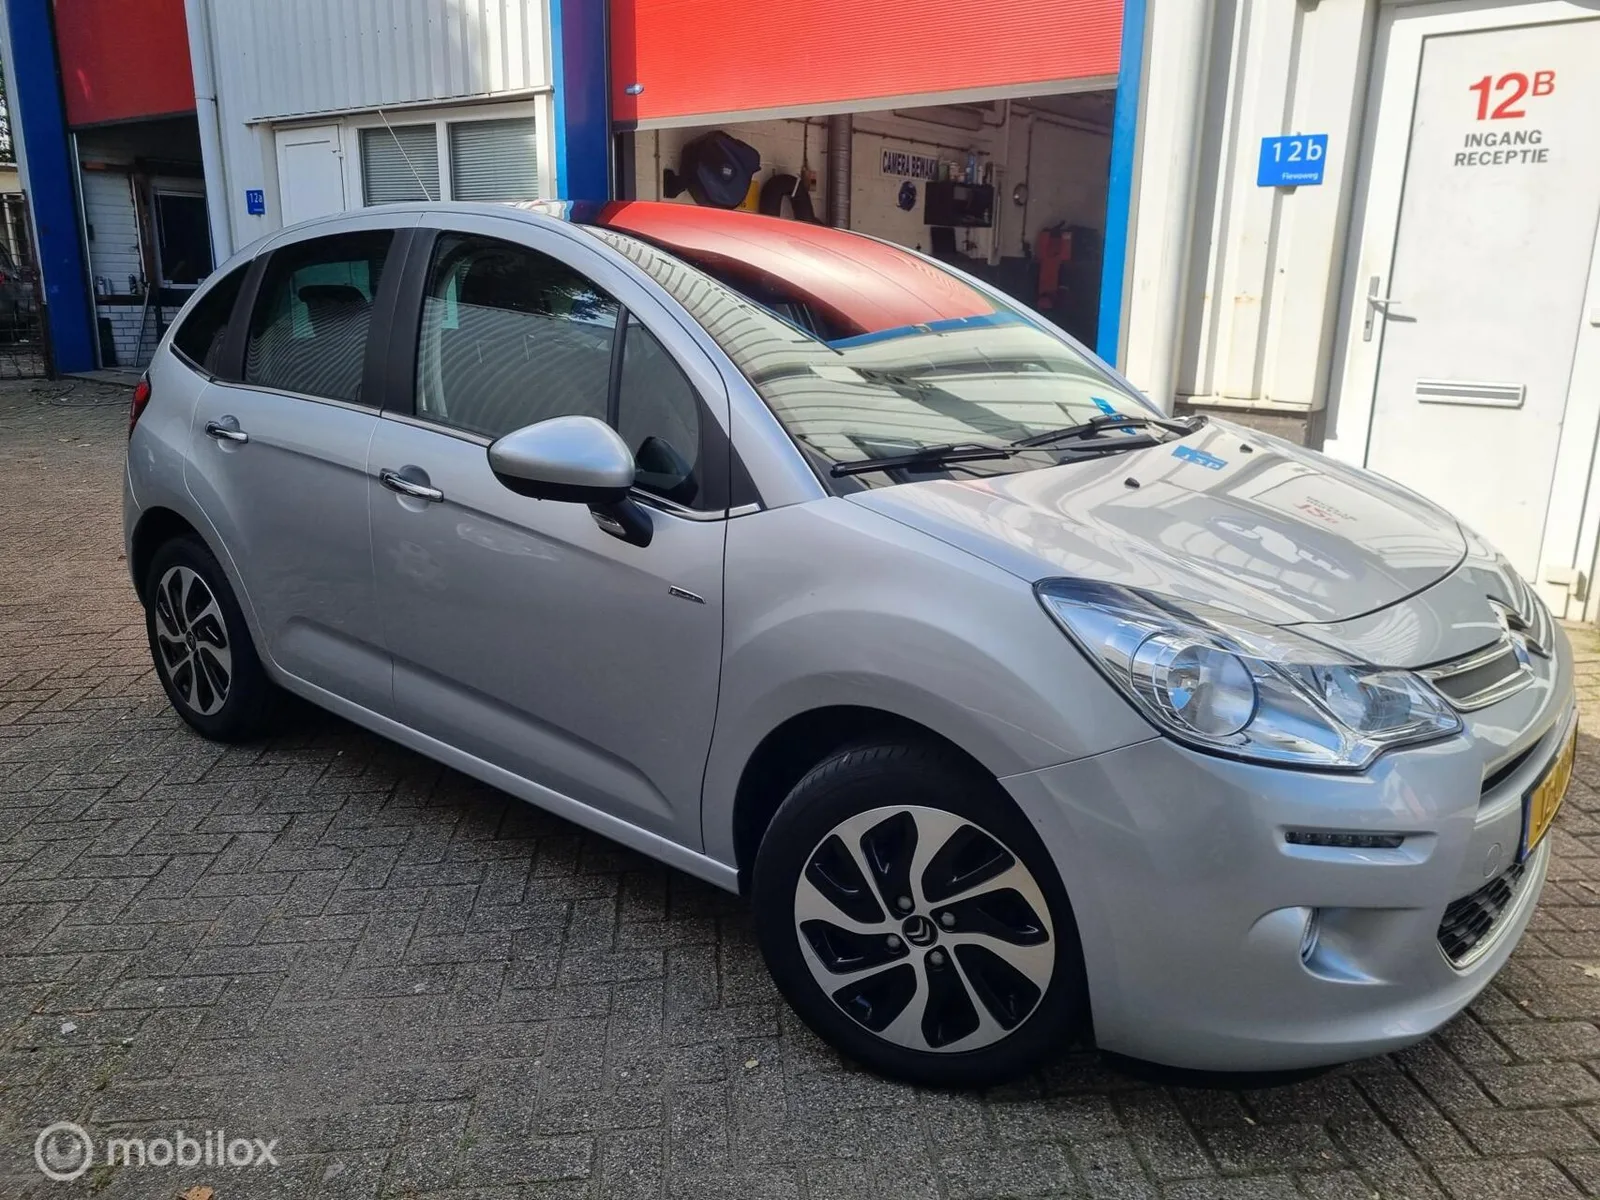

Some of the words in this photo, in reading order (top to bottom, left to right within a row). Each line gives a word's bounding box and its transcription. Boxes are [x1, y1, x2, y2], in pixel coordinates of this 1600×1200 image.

[1469, 70, 1556, 121] 12B
[1464, 129, 1543, 148] INGANG
[1273, 138, 1323, 163] 12b
[1454, 148, 1550, 166] RECEPTIE
[882, 150, 911, 176] CAMERA
[249, 192, 263, 204] 12a
